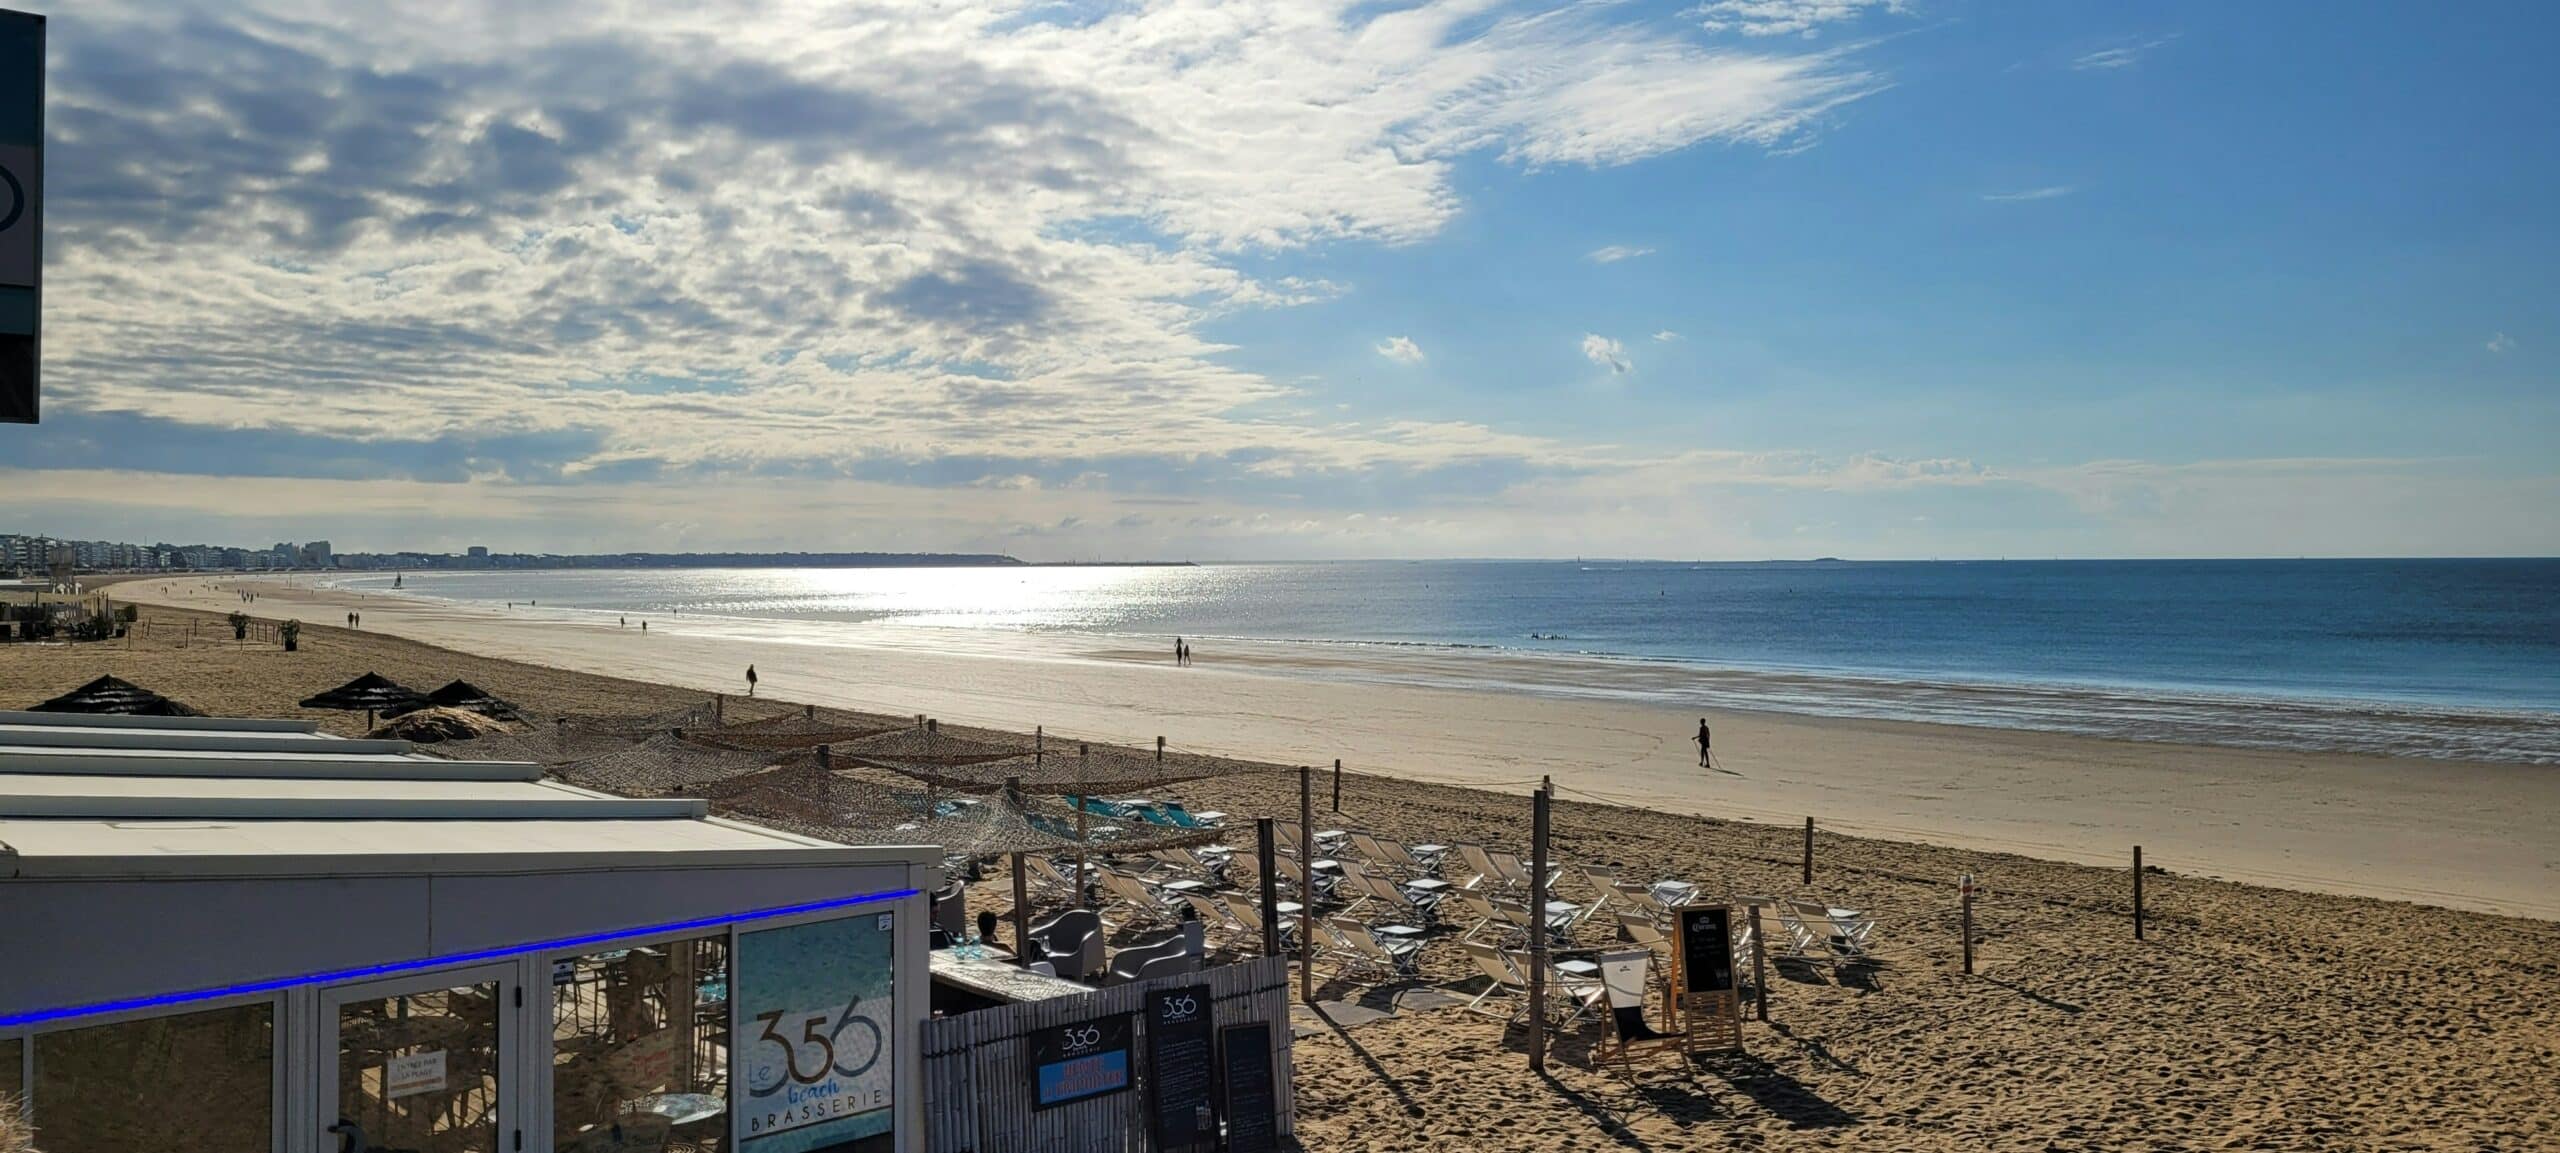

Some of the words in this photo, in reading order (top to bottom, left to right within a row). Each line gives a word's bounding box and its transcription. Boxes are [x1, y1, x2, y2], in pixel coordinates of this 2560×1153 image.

[1163, 994, 1197, 1017] 356
[750, 995, 882, 1098] 356
[1063, 1024, 1100, 1050] 356
[749, 1063, 771, 1083] Le
[787, 1078, 840, 1104] beach
[751, 1089, 882, 1131] BRASSERIE
